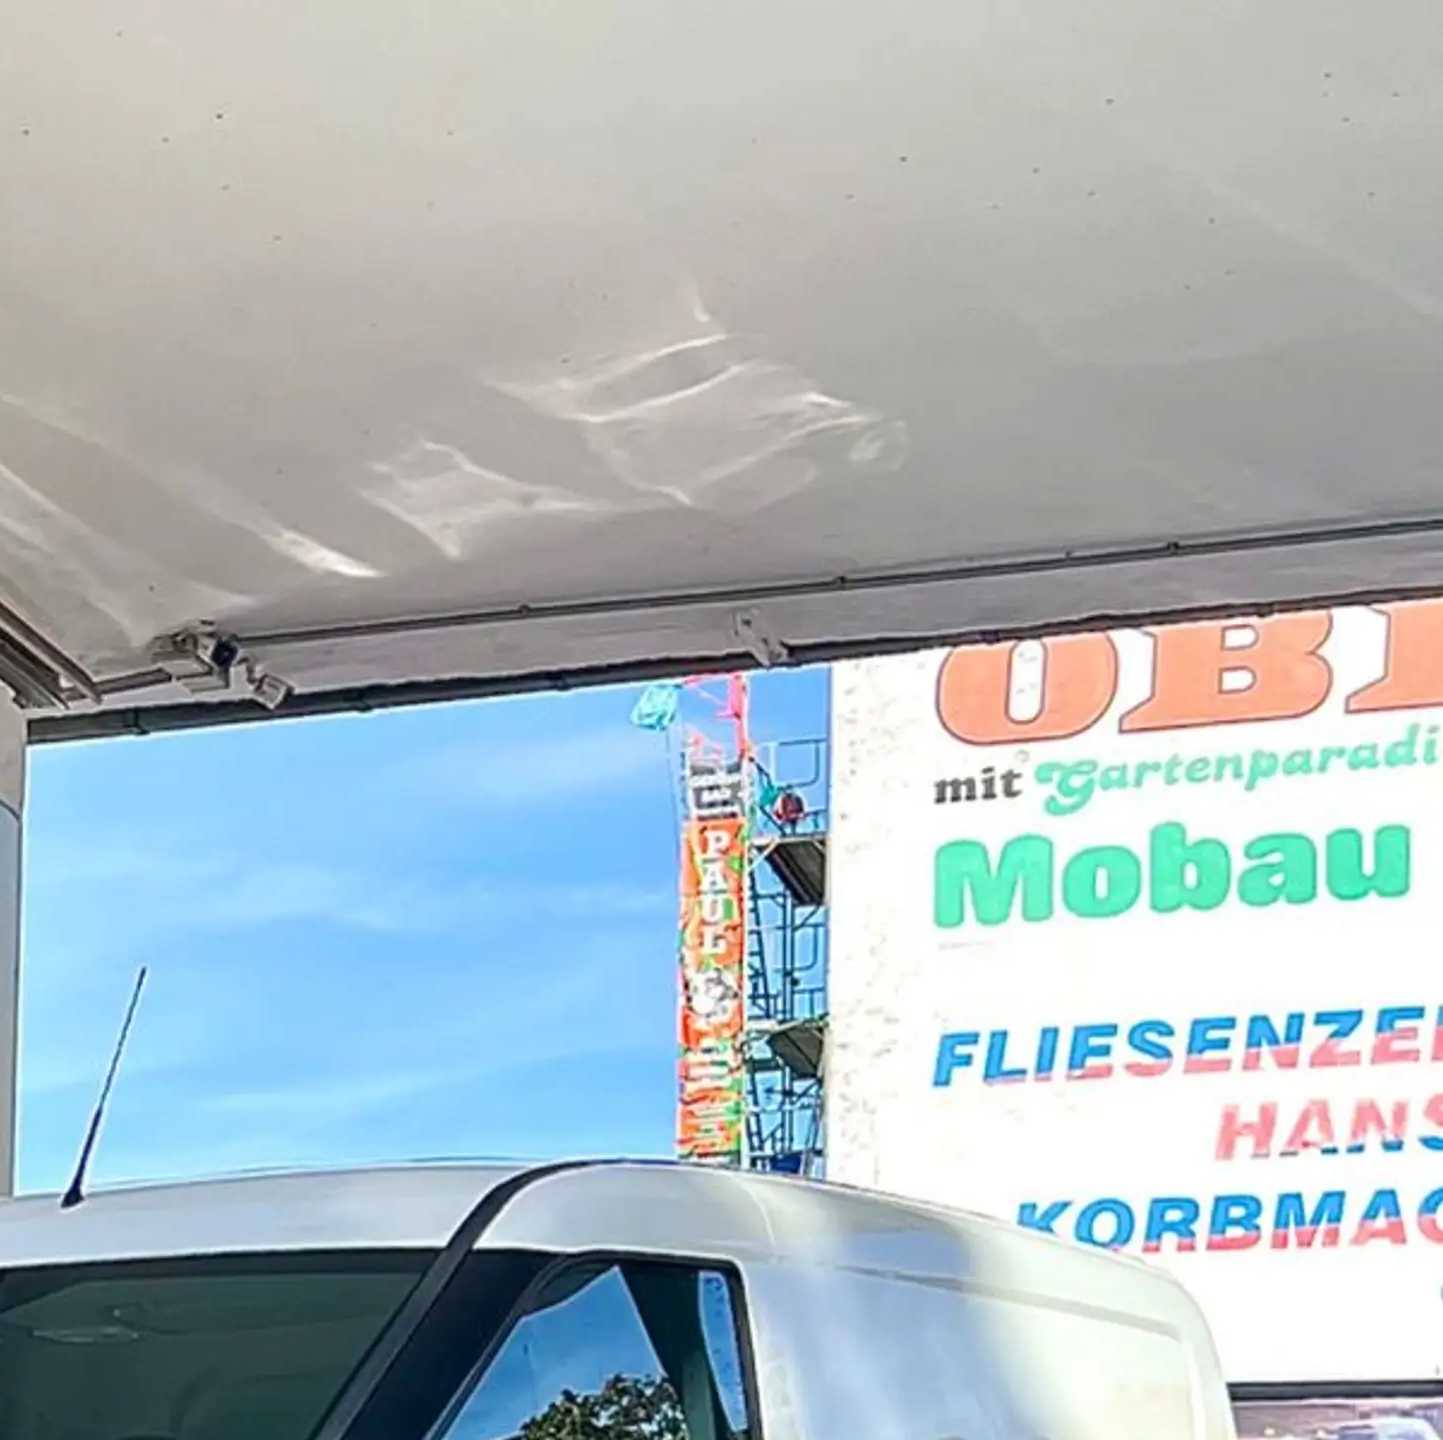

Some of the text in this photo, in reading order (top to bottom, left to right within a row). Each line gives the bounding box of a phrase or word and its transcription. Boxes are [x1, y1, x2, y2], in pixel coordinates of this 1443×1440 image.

[934, 766, 1022, 805] mit
[933, 820, 1411, 928] Mobau
[932, 1004, 1443, 1089] FLIESENZE
